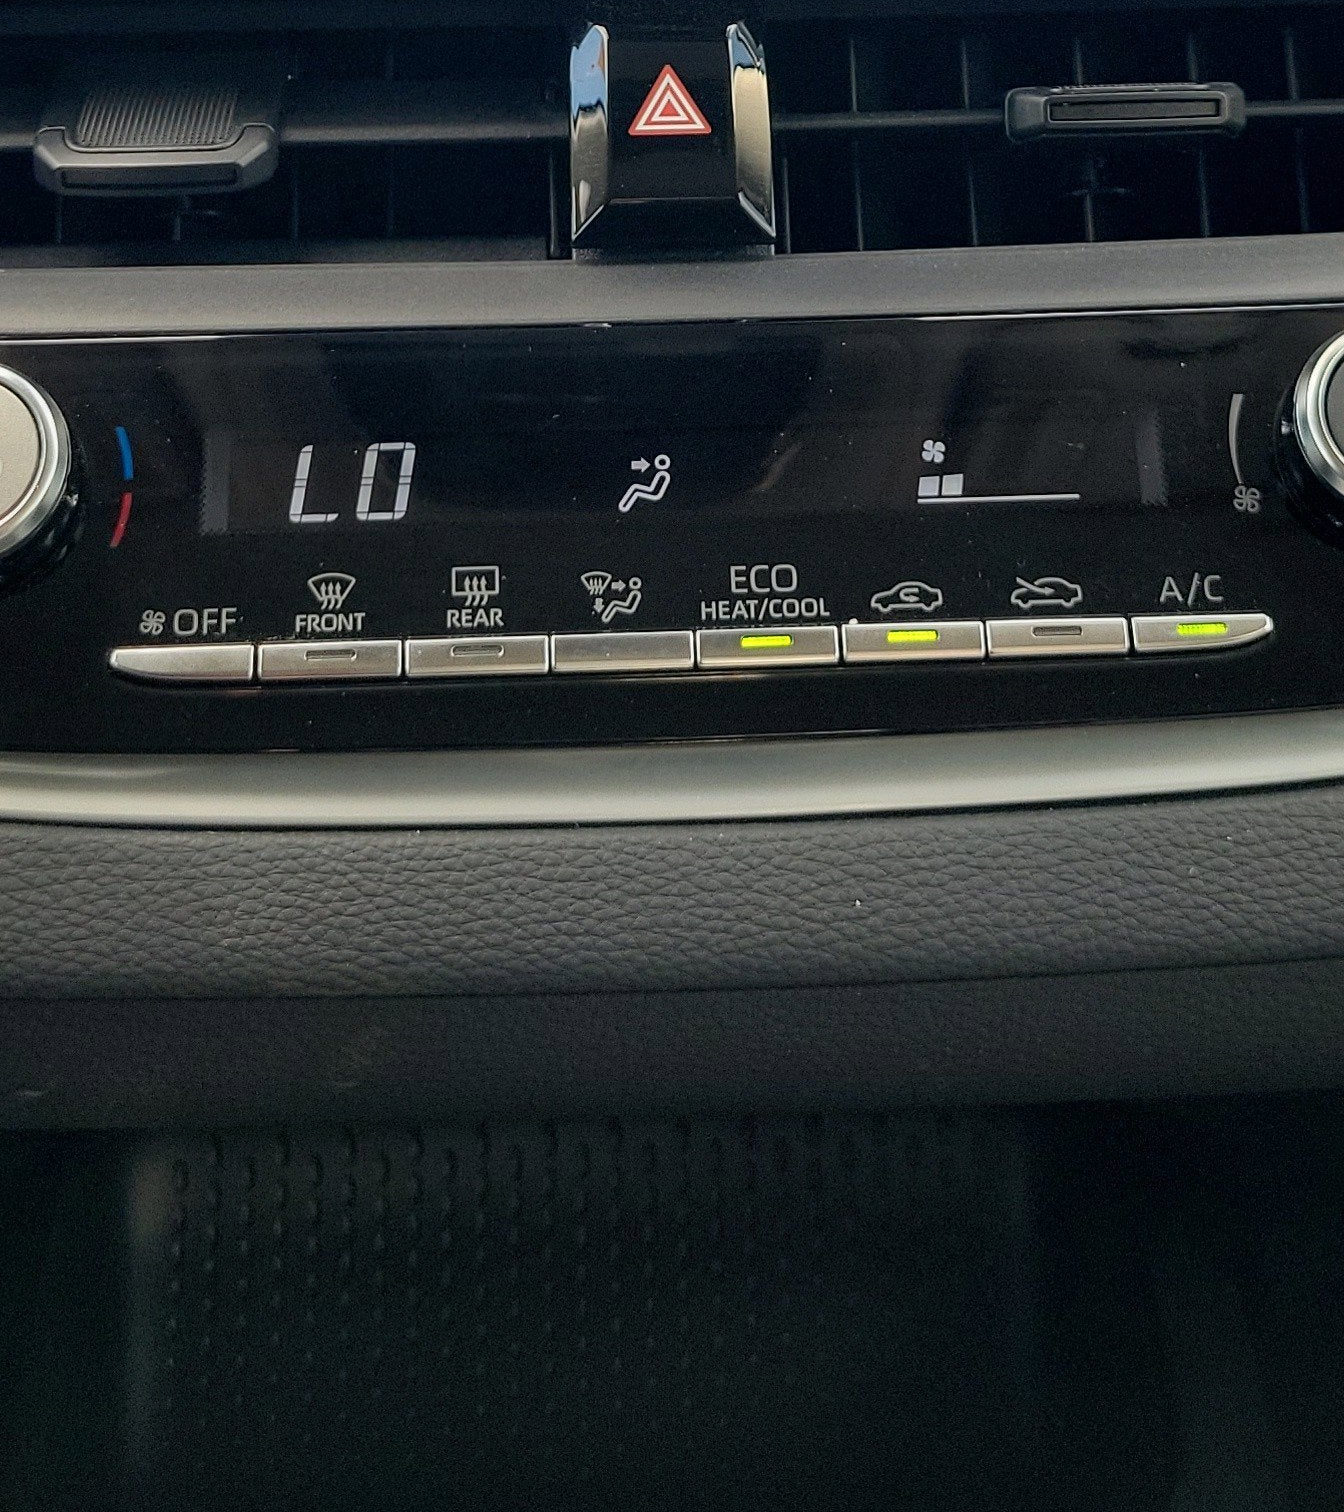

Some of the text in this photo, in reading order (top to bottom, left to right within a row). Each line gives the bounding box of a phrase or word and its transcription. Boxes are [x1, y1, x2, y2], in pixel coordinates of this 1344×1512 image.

[729, 564, 799, 593] ECO
[1160, 573, 1223, 606] A/C
[173, 607, 238, 636] OFF
[294, 612, 366, 633] FRONT
[447, 607, 504, 628] REAR
[700, 598, 831, 621] HEAT/COOL
